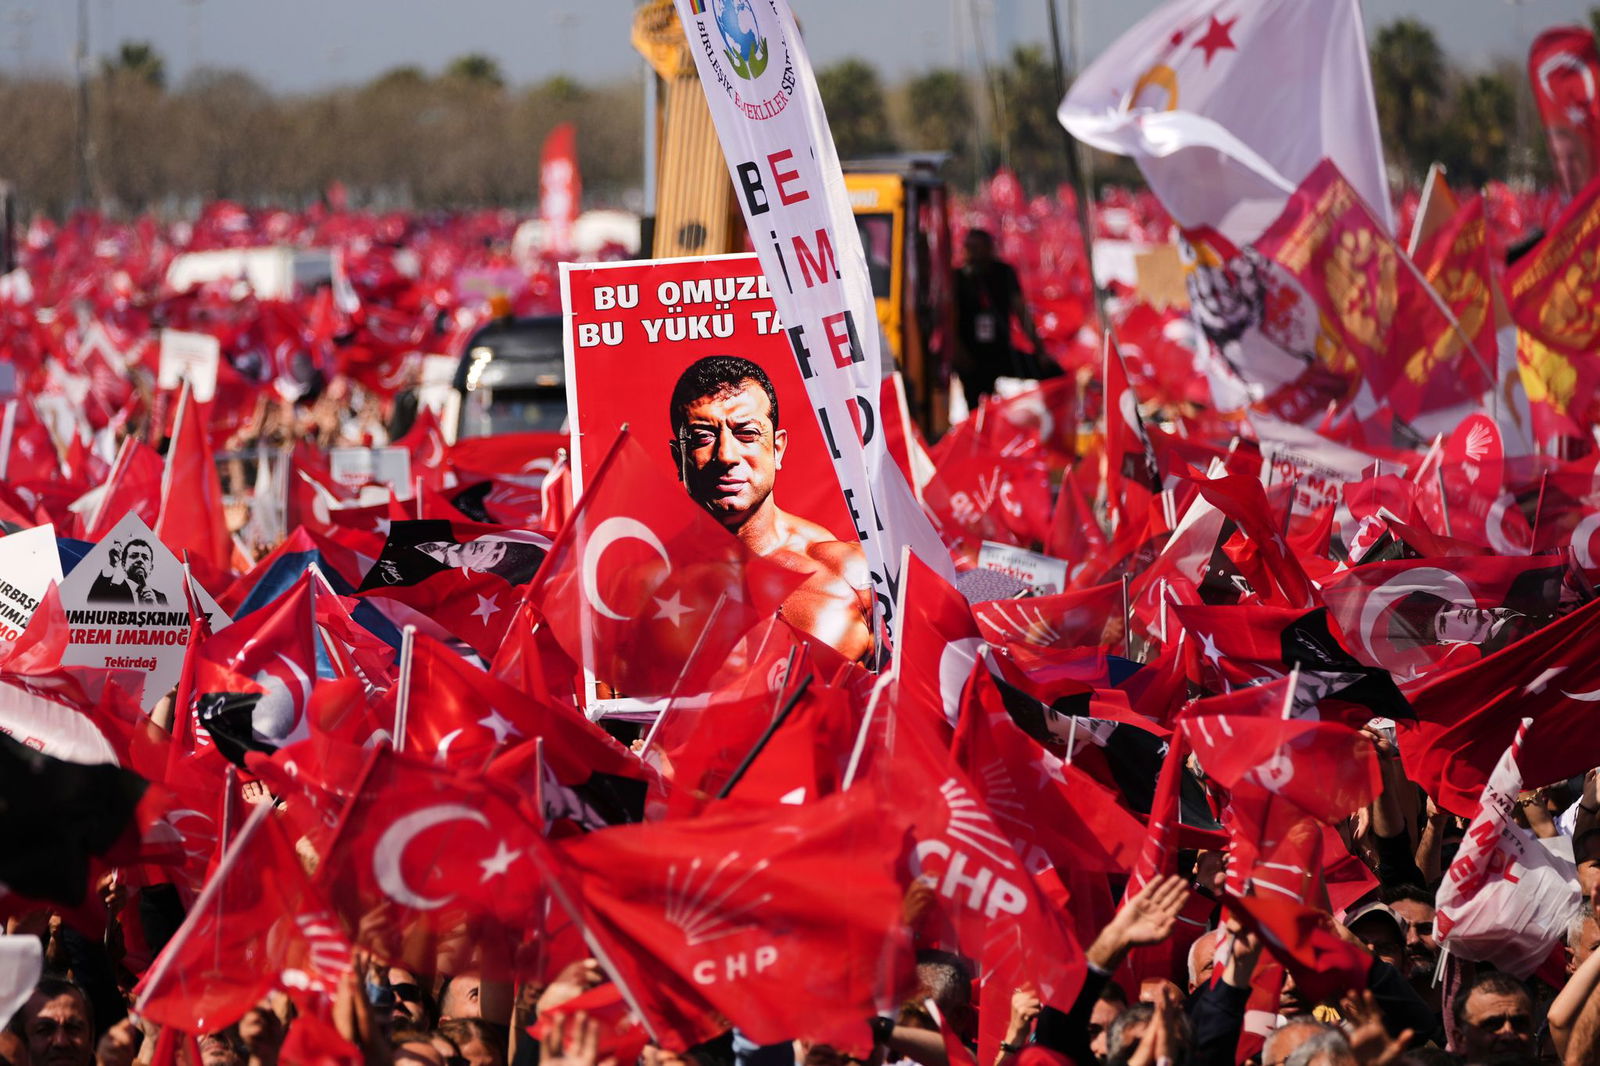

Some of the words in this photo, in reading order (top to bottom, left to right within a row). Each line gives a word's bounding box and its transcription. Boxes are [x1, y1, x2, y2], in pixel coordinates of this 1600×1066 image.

[594, 284, 639, 311] BU
[578, 321, 624, 349] BU
[642, 304, 735, 344] YÜKÜ
[69, 628, 112, 645] KREM
[116, 628, 191, 646] İMAMOĞ
[105, 656, 157, 671] Tekirdağ
[911, 839, 1029, 919] CHP
[693, 946, 779, 985] CHP
